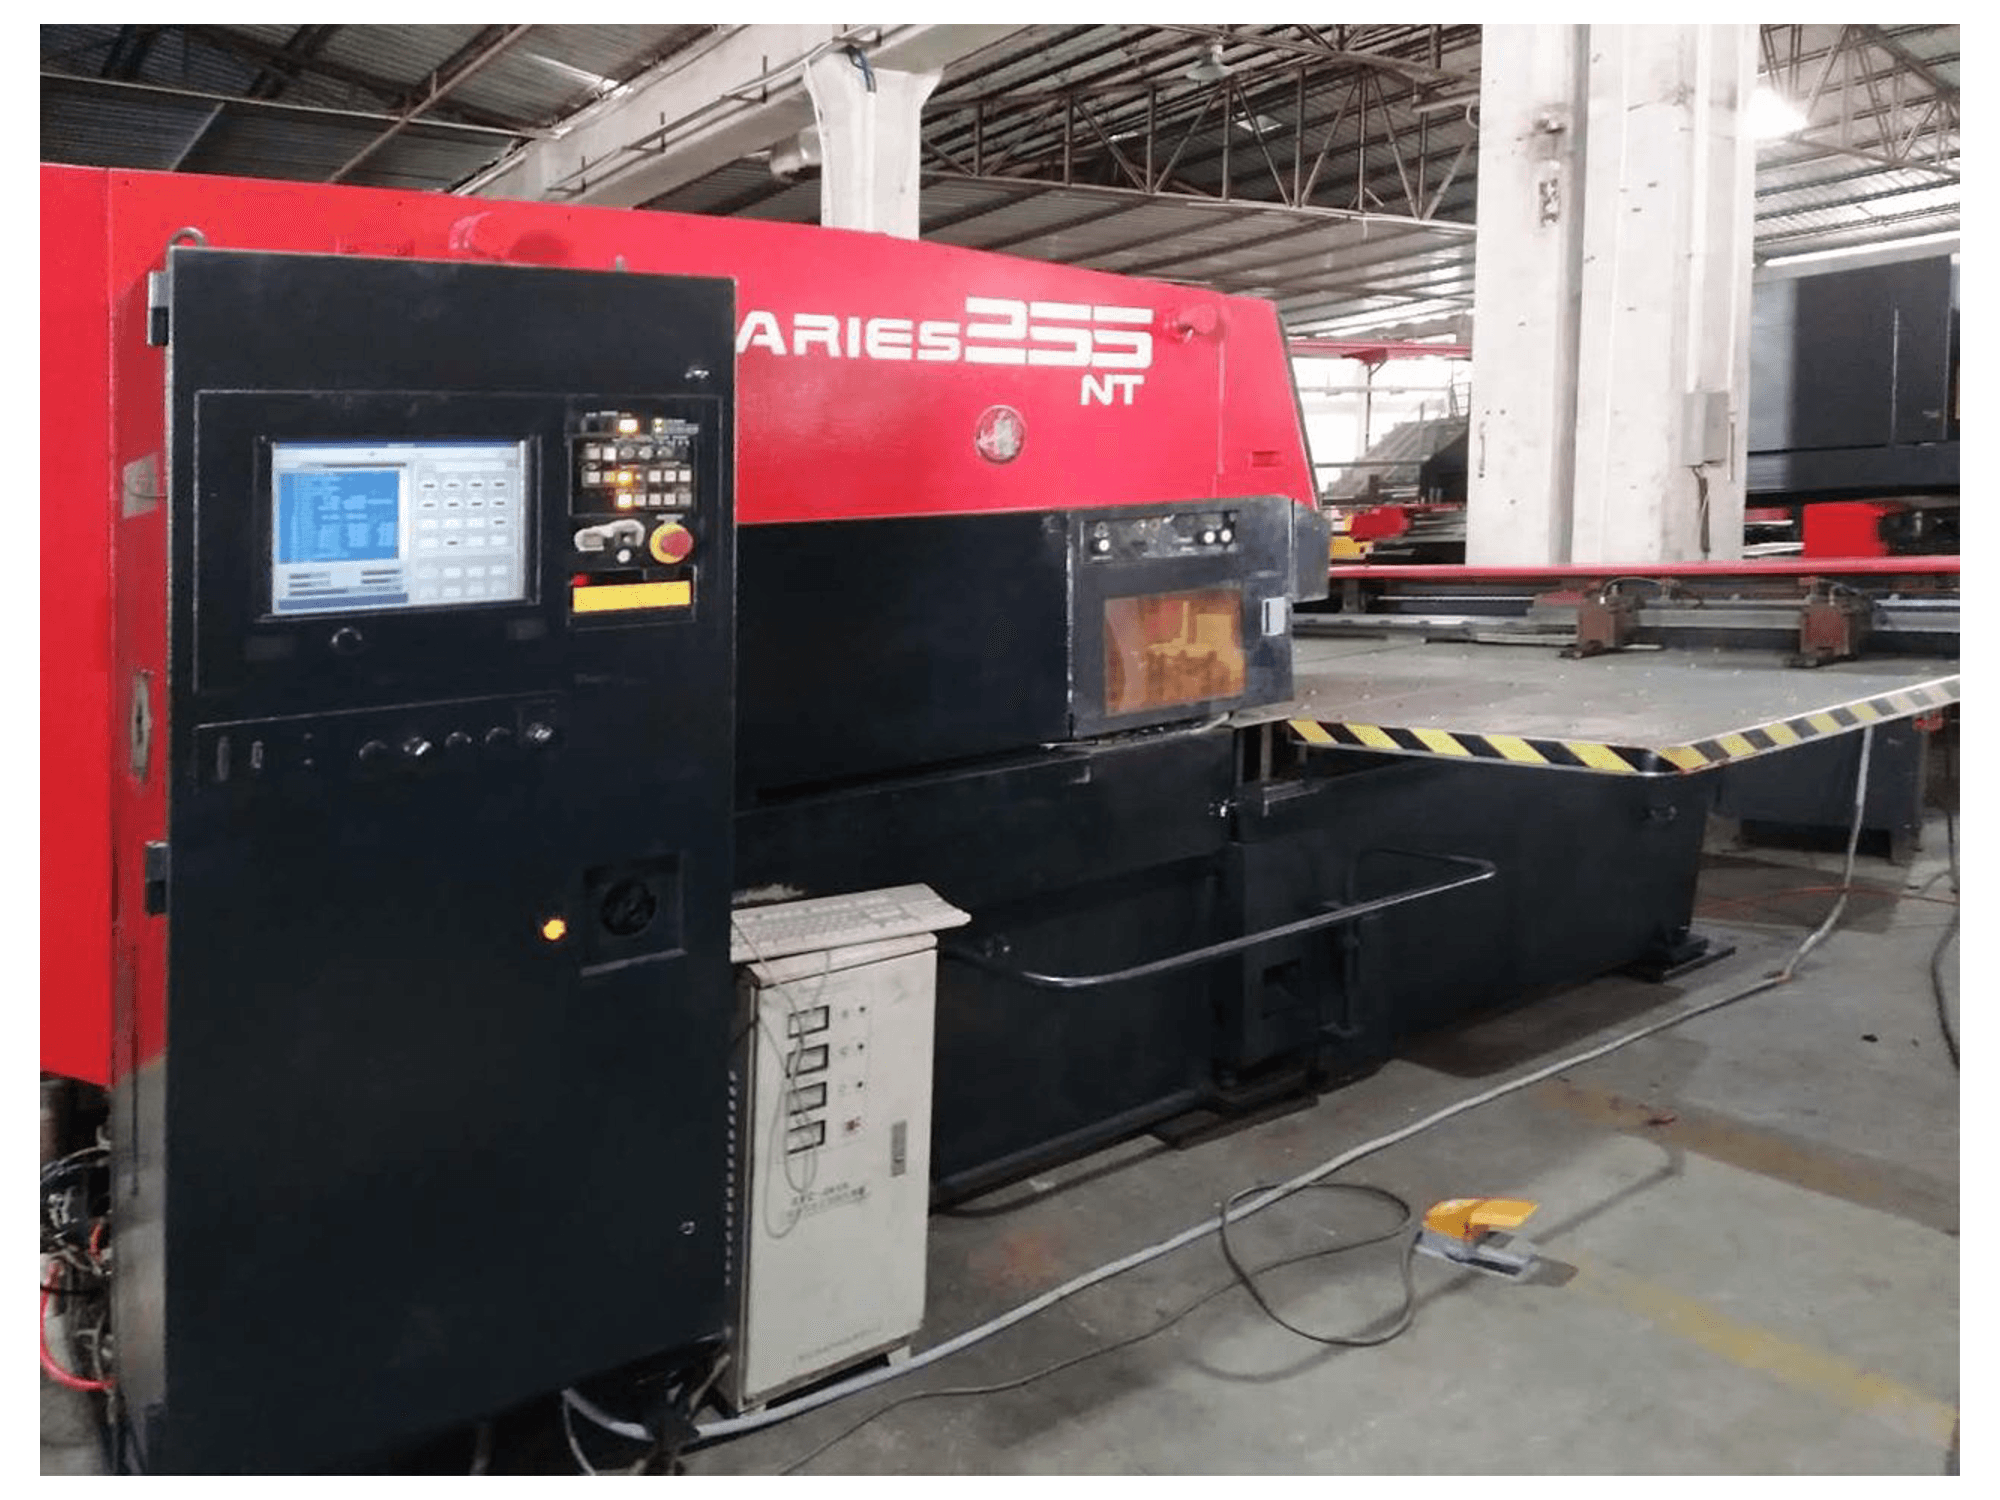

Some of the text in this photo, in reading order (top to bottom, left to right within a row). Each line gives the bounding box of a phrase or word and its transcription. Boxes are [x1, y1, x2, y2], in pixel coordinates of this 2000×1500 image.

[736, 296, 1154, 369] ARIES 255
[1080, 373, 1145, 407] NT
